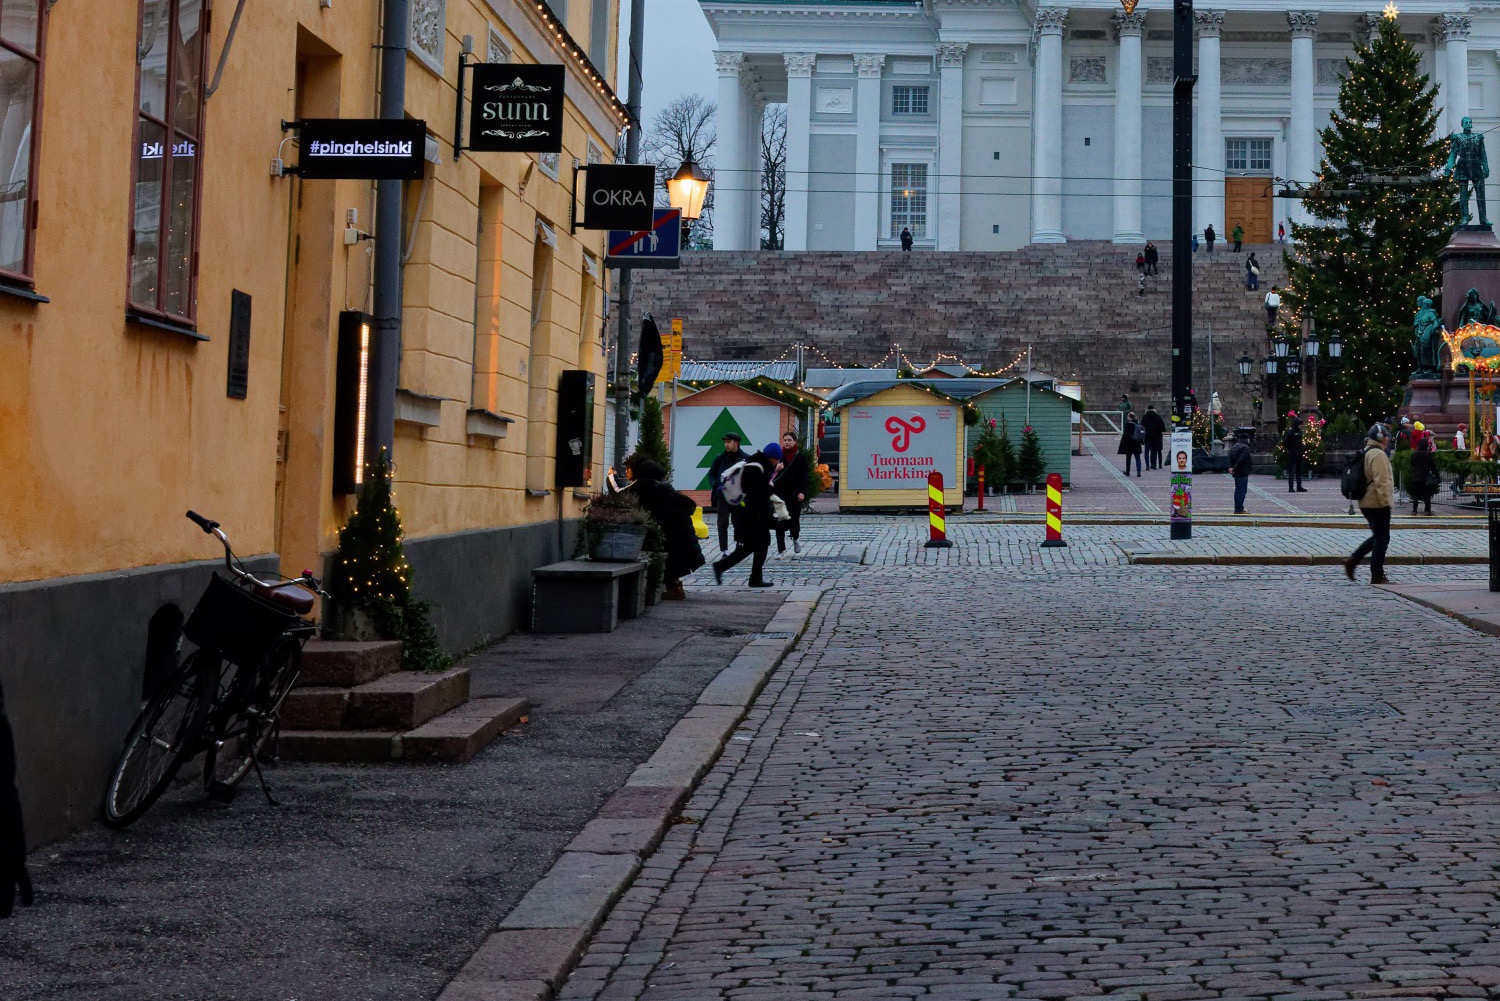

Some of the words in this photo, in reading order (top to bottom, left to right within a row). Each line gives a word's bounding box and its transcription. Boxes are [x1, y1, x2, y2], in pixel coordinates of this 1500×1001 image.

[483, 101, 550, 121] sunn
[309, 140, 413, 156] #pinghelsinki
[592, 189, 647, 206] OKRA
[871, 453, 933, 466] Tuomaan
